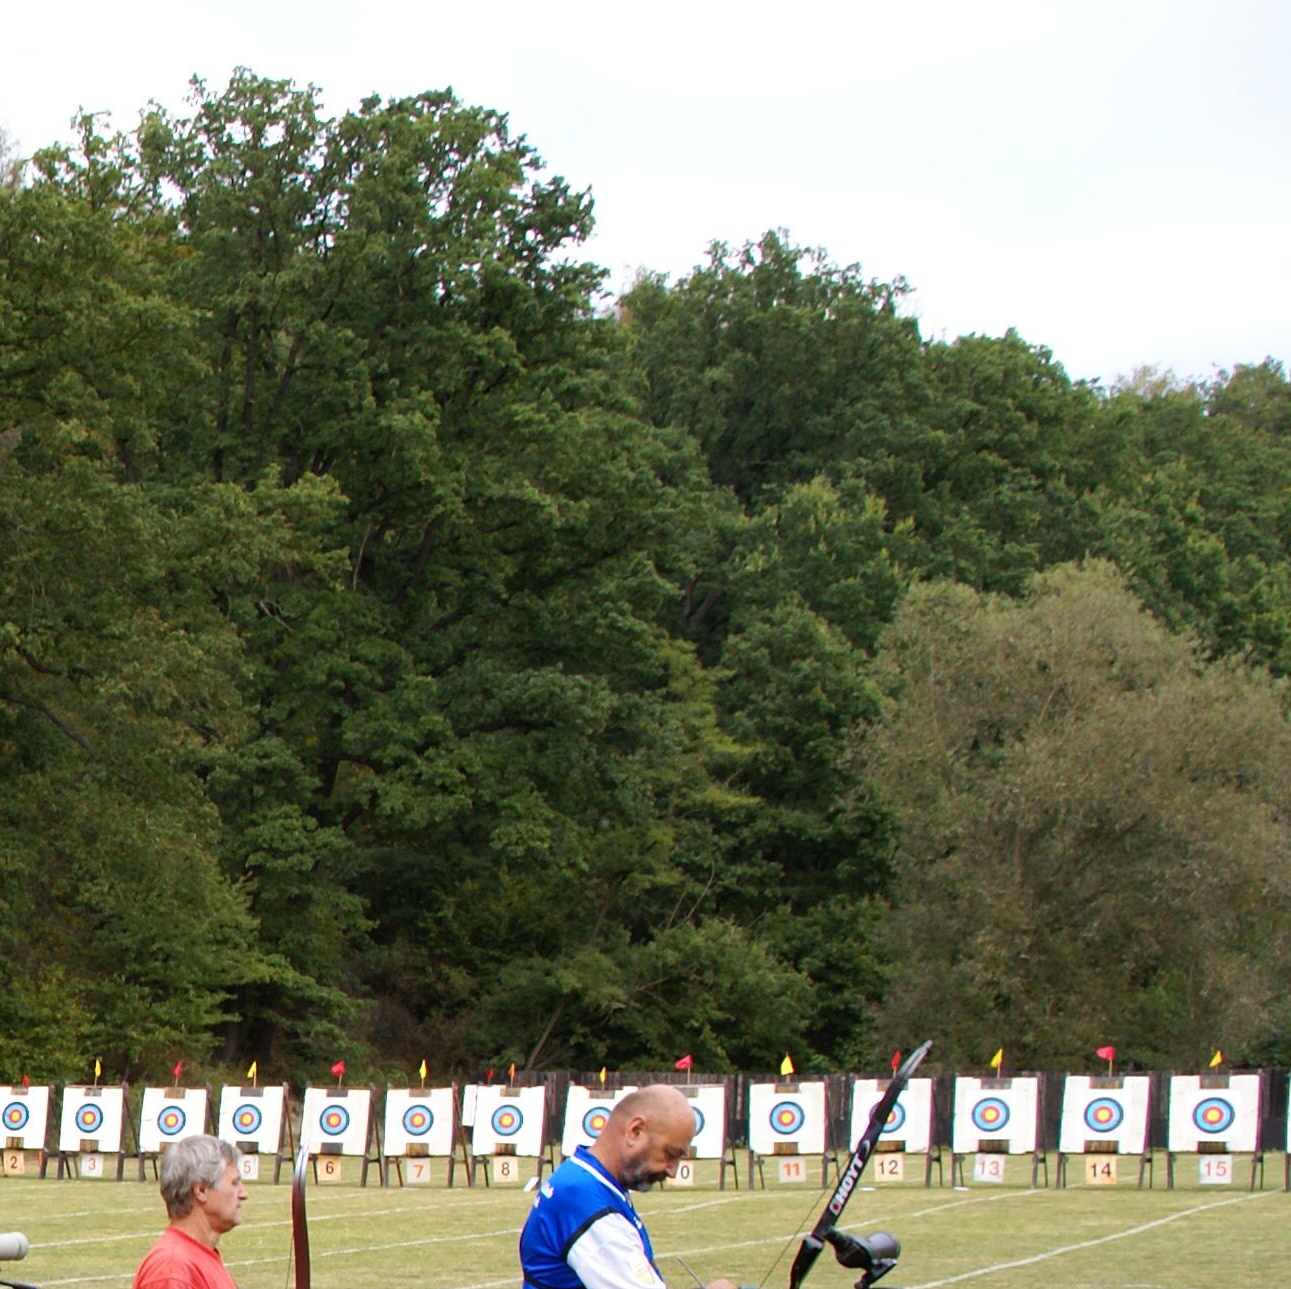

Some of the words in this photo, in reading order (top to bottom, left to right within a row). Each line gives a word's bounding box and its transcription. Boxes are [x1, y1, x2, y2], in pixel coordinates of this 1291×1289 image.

[10, 1155, 18, 1169] 2
[87, 1157, 96, 1171] 3
[243, 1159, 252, 1174] 5
[325, 1160, 335, 1175] 6
[501, 1162, 511, 1176] 8
[782, 1162, 801, 1177] 11
[877, 1160, 899, 1175] 12
[977, 1160, 1001, 1176] 13
[1203, 1162, 1228, 1177] 15
[413, 1164, 424, 1178] 7
[833, 1152, 864, 1204] HOYT
[1090, 1163, 1112, 1178] 14
